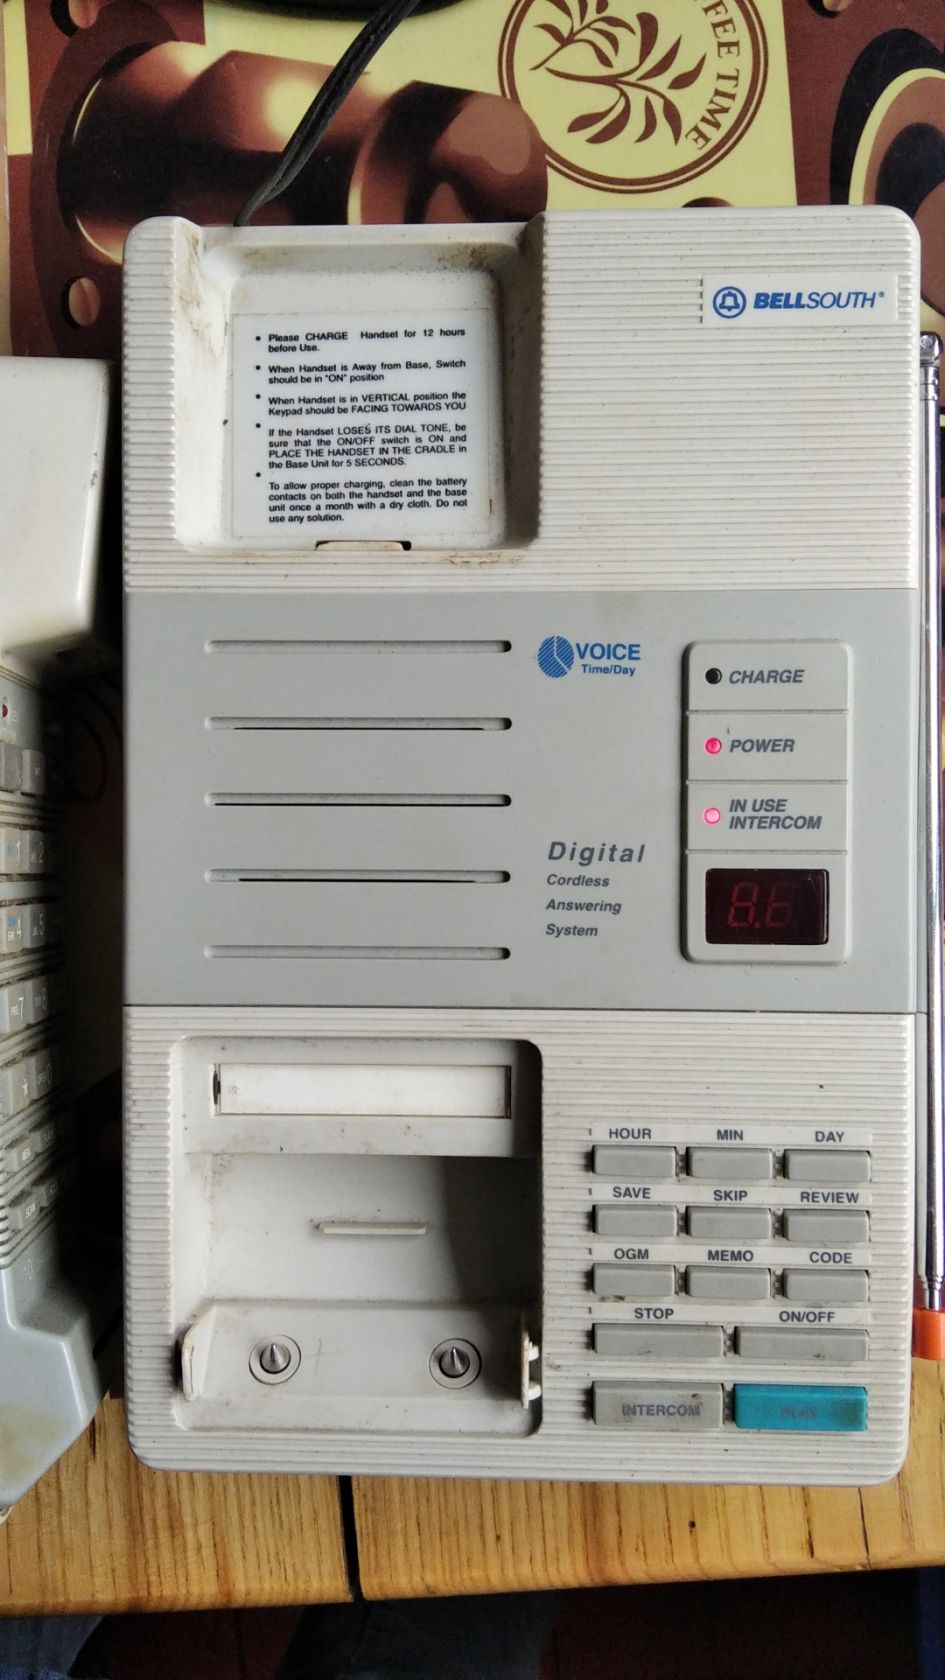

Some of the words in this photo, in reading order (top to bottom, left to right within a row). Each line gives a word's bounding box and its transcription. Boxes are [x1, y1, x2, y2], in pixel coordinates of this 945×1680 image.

[702, 0, 740, 58] FEE
[685, 68, 740, 150] TIME
[268, 333, 299, 342] Please
[305, 332, 348, 341] CHARGE
[360, 330, 398, 339] Handset
[404, 330, 416, 338] for
[440, 328, 465, 336] hours
[268, 344, 297, 353] before
[300, 343, 319, 352] Use.
[269, 365, 295, 373] When
[299, 364, 336, 372] Handset
[341, 363, 348, 371] is
[352, 362, 376, 372] Away
[381, 362, 401, 370] from
[406, 361, 430, 370] Base,
[436, 360, 466, 368] Switch
[269, 375, 298, 384] should
[300, 375, 312, 383] be
[350, 373, 384, 383] position
[269, 397, 295, 405] When
[298, 396, 335, 404] Handset
[350, 394, 358, 402] in
[361, 394, 410, 402] VERTICAL
[414, 392, 448, 402] position
[452, 391, 466, 399] the
[269, 407, 303, 416] Keypad
[306, 406, 335, 414] should
[338, 405, 349, 414] be
[351, 404, 388, 413] FACING
[391, 403, 442, 411] TOWARDS
[445, 402, 466, 410] YOU
[269, 429, 276, 437] If
[278, 428, 293, 436] the
[296, 427, 334, 435] Handset
[338, 426, 371, 434] LOSES
[375, 425, 391, 434] ITS
[394, 425, 416, 433] DIAL
[421, 424, 451, 433] TONE,
[294, 438, 311, 447] that
[317, 438, 332, 446] the
[337, 437, 375, 445] ON/OFF
[381, 436, 409, 444] switch
[415, 436, 422, 444] is
[429, 435, 444, 443] ON
[450, 434, 466, 442] and
[269, 449, 301, 458] PLACE
[305, 448, 324, 457] THE
[328, 448, 375, 456] HANDSET
[379, 447, 388, 455] IN
[392, 446, 411, 454] THE
[415, 445, 455, 454] CRADLE
[459, 445, 466, 453] in
[269, 460, 283, 468] the
[286, 459, 308, 468] Base
[311, 459, 329, 467] Unit
[332, 458, 343, 466] for
[346, 458, 352, 466] 5
[355, 457, 406, 466] SECONDS.
[269, 482, 280, 490] To
[284, 481, 306, 489] allow
[311, 482, 340, 491] proper
[344, 479, 386, 490] charging,
[390, 479, 414, 487] clean
[418, 478, 432, 486] the
[436, 477, 467, 488] battery
[326, 491, 345, 499] both
[349, 491, 363, 499] the
[367, 489, 403, 498] handset
[407, 489, 423, 497] and
[427, 488, 441, 496] the
[445, 488, 467, 496] base
[269, 503, 285, 511] unit
[326, 502, 353, 510] month
[358, 501, 376, 509] with
[390, 500, 404, 510] dry
[407, 499, 431, 508] cloth.
[436, 499, 449, 507] Do
[288, 515, 303, 524] any
[307, 513, 344, 521] solution.
[575, 643, 641, 661] VOICE
[582, 664, 636, 677] Time/Day
[729, 670, 804, 684] CHARGE
[729, 739, 795, 752] POWER
[729, 799, 747, 813] IN
[752, 799, 787, 813] USE
[729, 816, 822, 830] INTERCOM
[548, 842, 645, 866] Digital
[547, 874, 610, 887] Cordless
[546, 899, 622, 915] Answering
[546, 924, 598, 937] System
[609, 1128, 652, 1140] HOUR
[717, 1130, 744, 1141] MIN
[815, 1131, 845, 1143] DAY
[613, 1187, 651, 1199] SAVE
[714, 1190, 748, 1201] SKIP
[800, 1192, 859, 1204] REVIEW
[614, 1249, 649, 1260] OGM
[707, 1250, 754, 1262] MEMO
[809, 1252, 853, 1264] CODE
[634, 1308, 674, 1320] STOP
[779, 1311, 835, 1323] ON/OFF
[622, 1404, 700, 1417] INTERCOM
